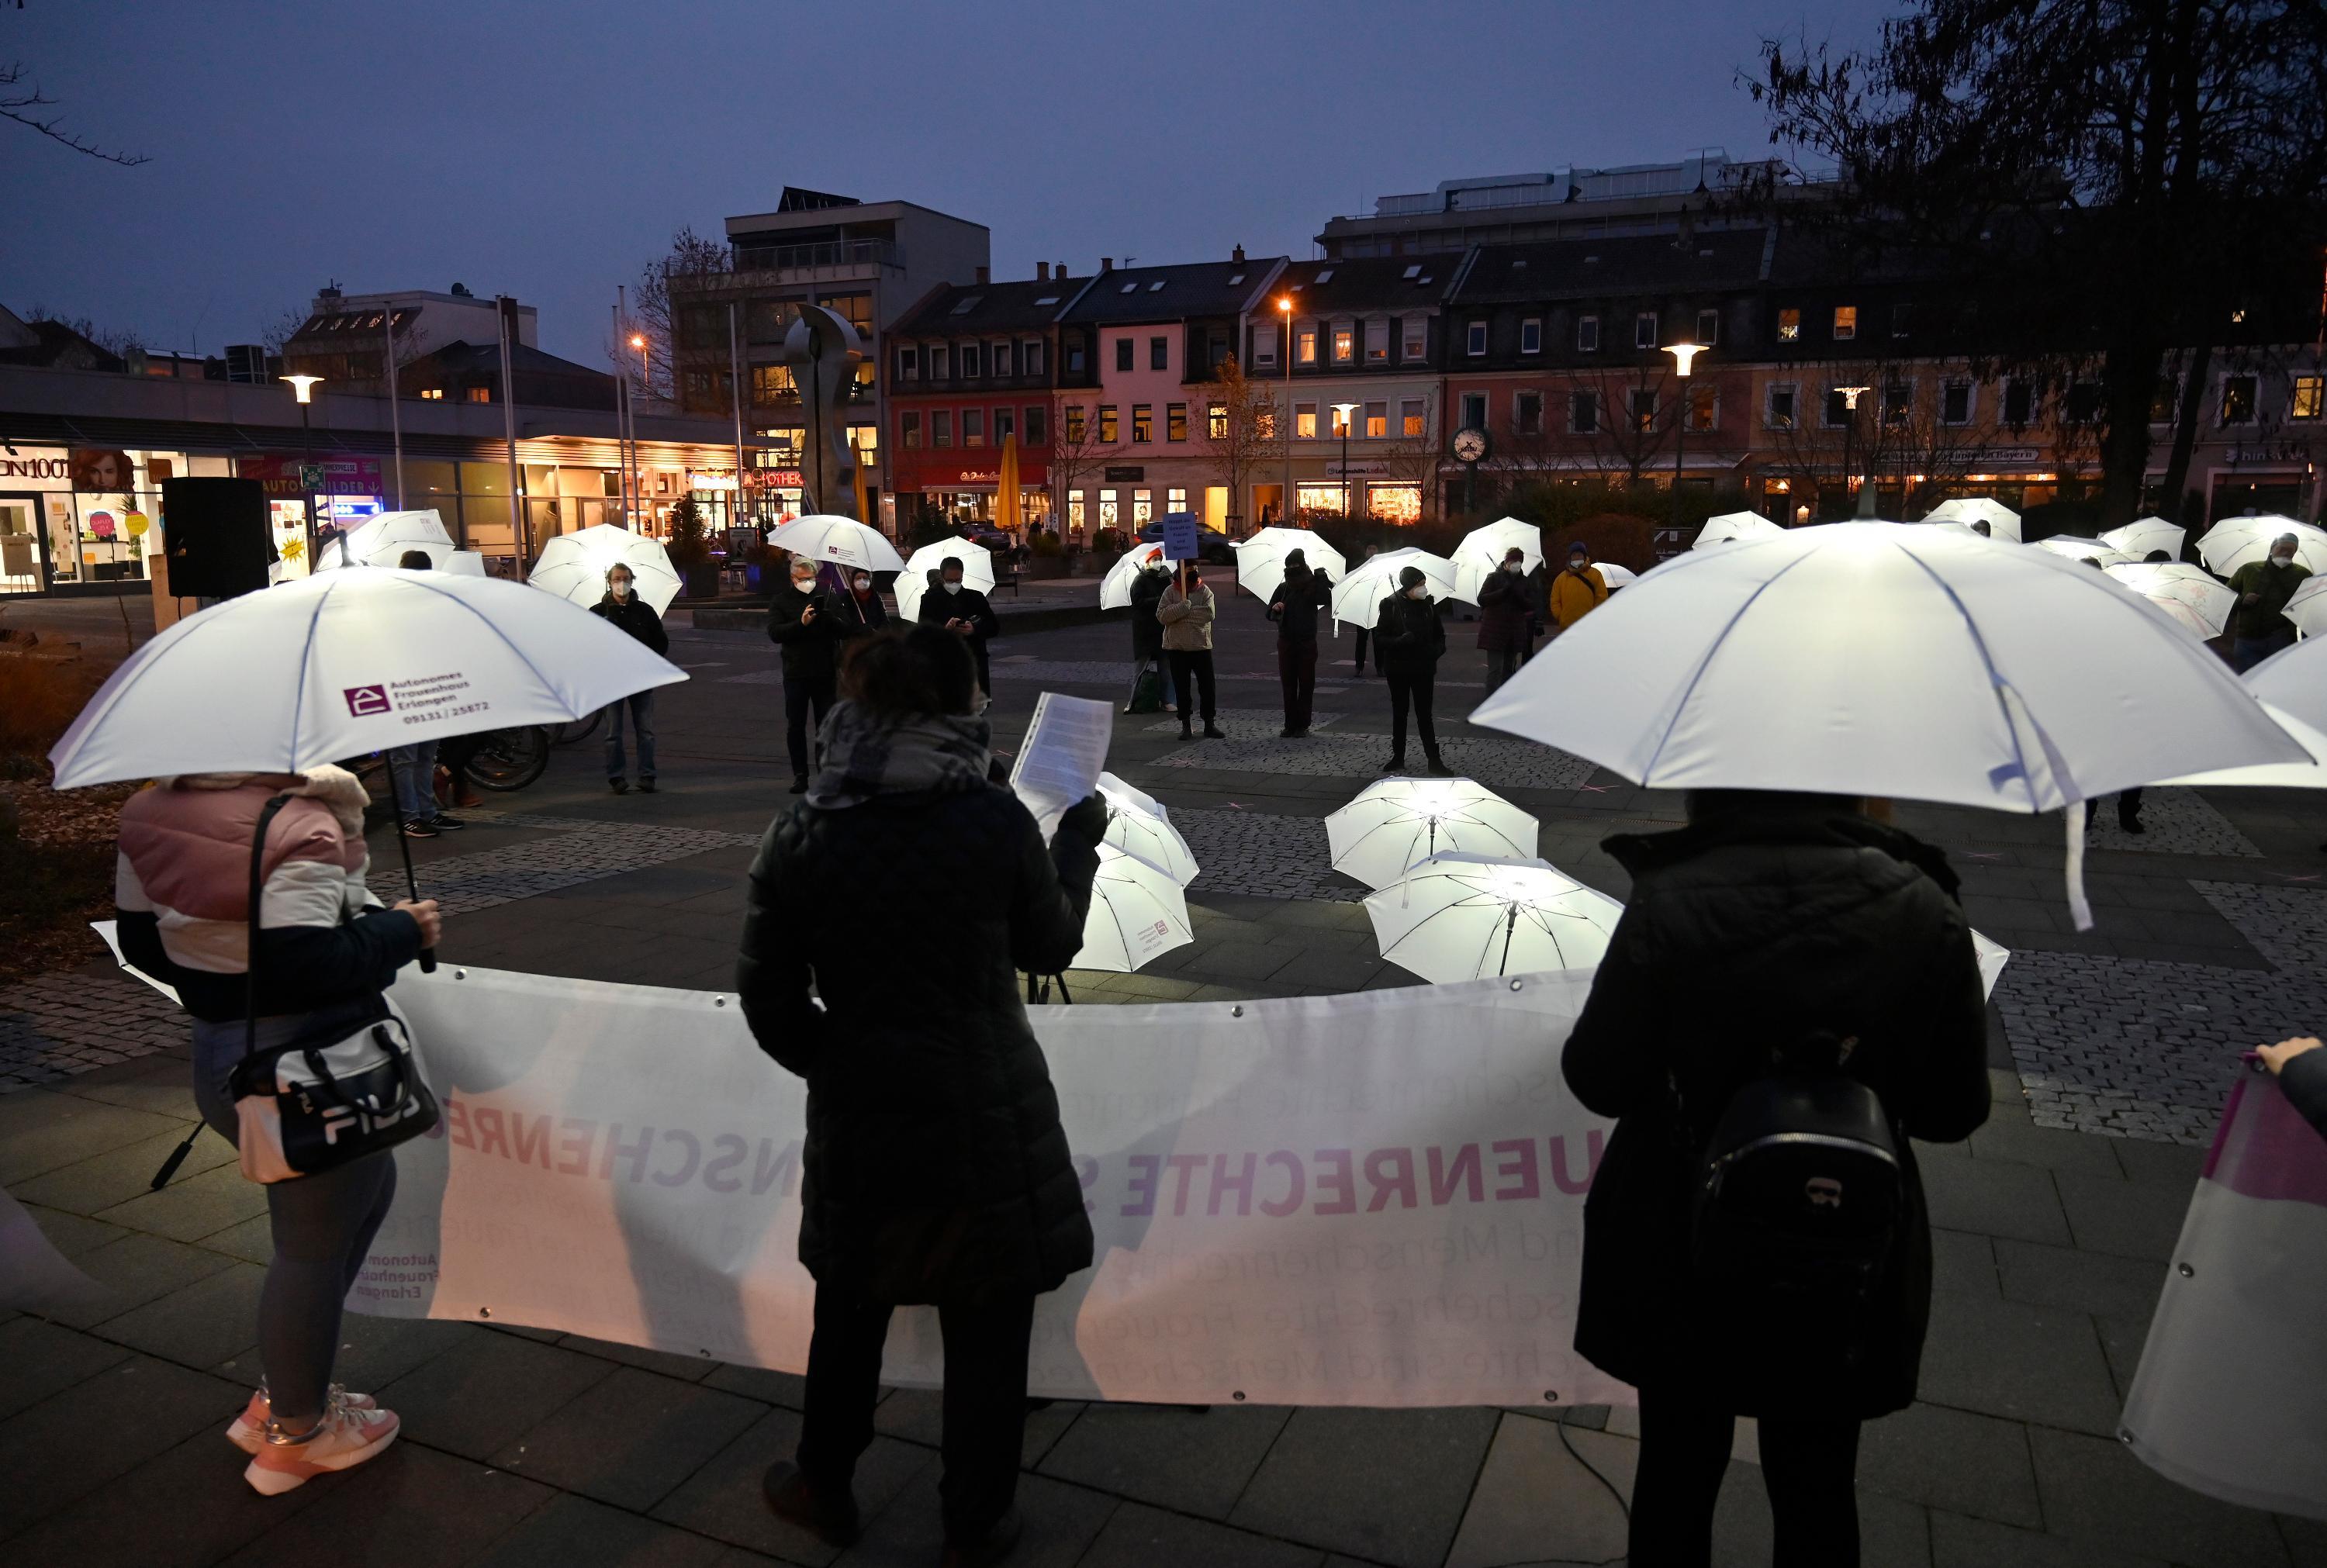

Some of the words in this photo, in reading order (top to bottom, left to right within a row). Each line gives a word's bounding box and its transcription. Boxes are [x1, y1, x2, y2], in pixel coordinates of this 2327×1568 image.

[261, 479, 365, 494] AUTOHILDER
[744, 473, 804, 485] APOTHEK
[390, 672, 463, 689] Autonomes
[394, 681, 470, 699] Frauenhaus
[398, 693, 458, 711] Erlangen
[321, 1082, 420, 1145] FILA
